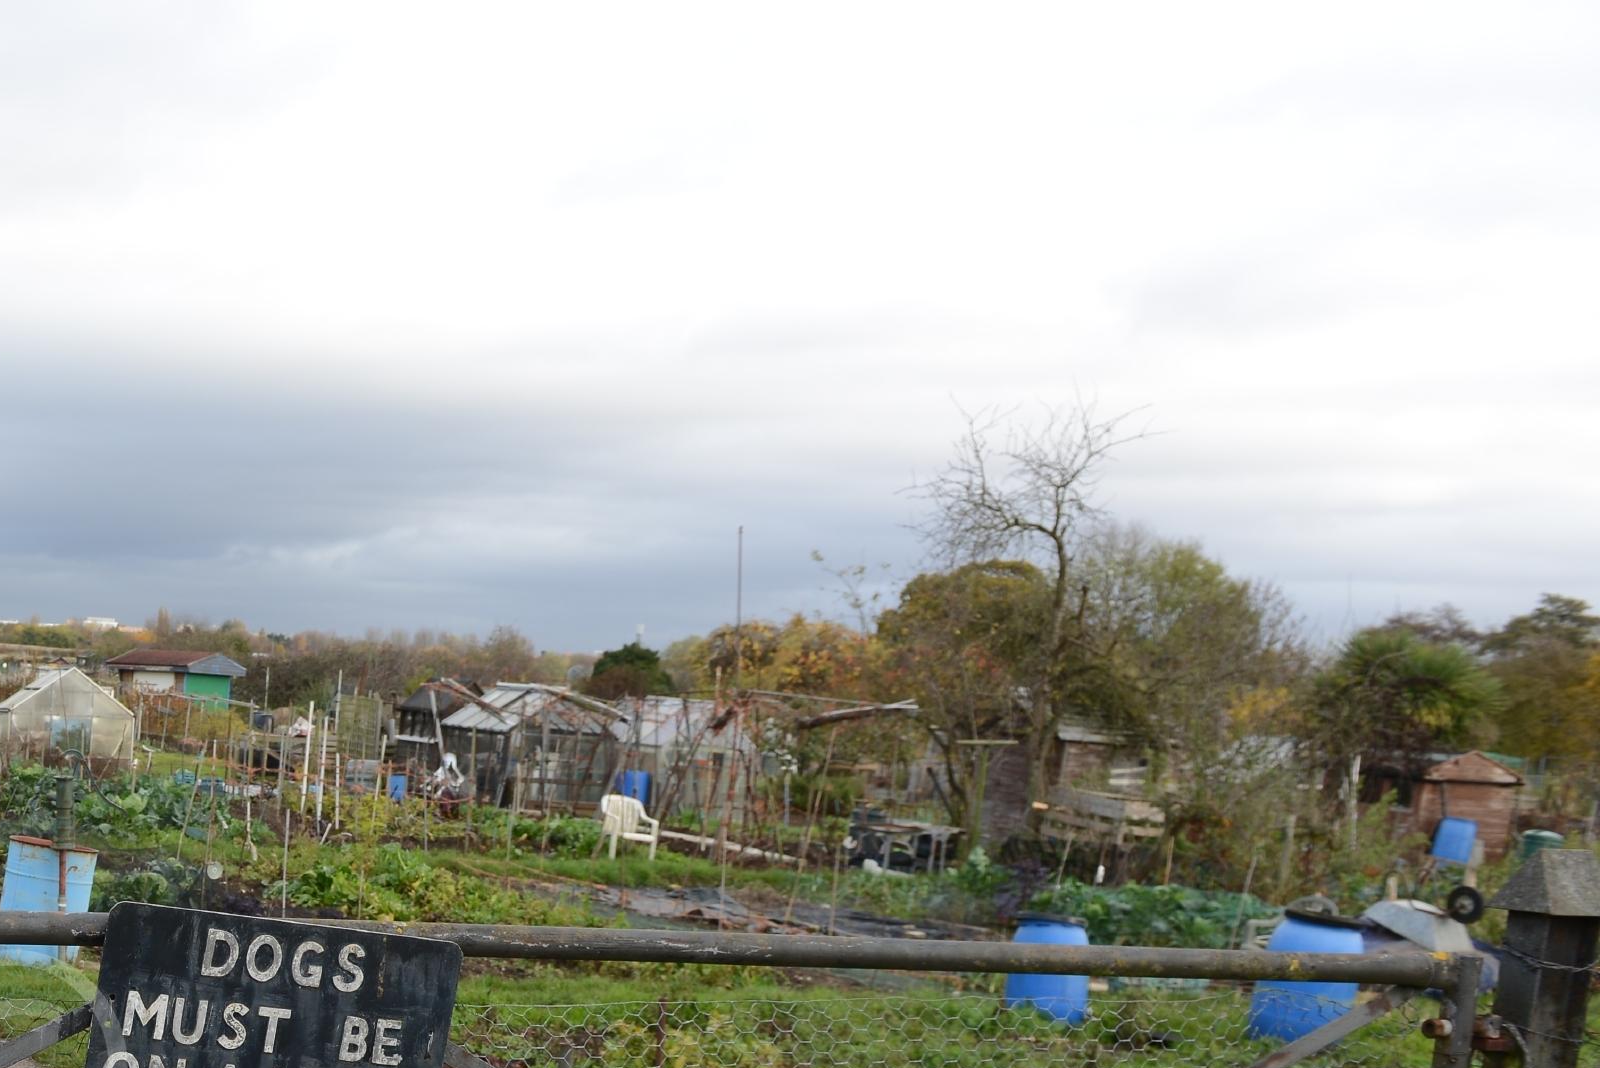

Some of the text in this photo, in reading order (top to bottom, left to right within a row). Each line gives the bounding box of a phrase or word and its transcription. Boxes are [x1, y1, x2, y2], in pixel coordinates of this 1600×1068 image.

[201, 928, 365, 993] DOGS
[122, 991, 402, 1066] MUST BE
